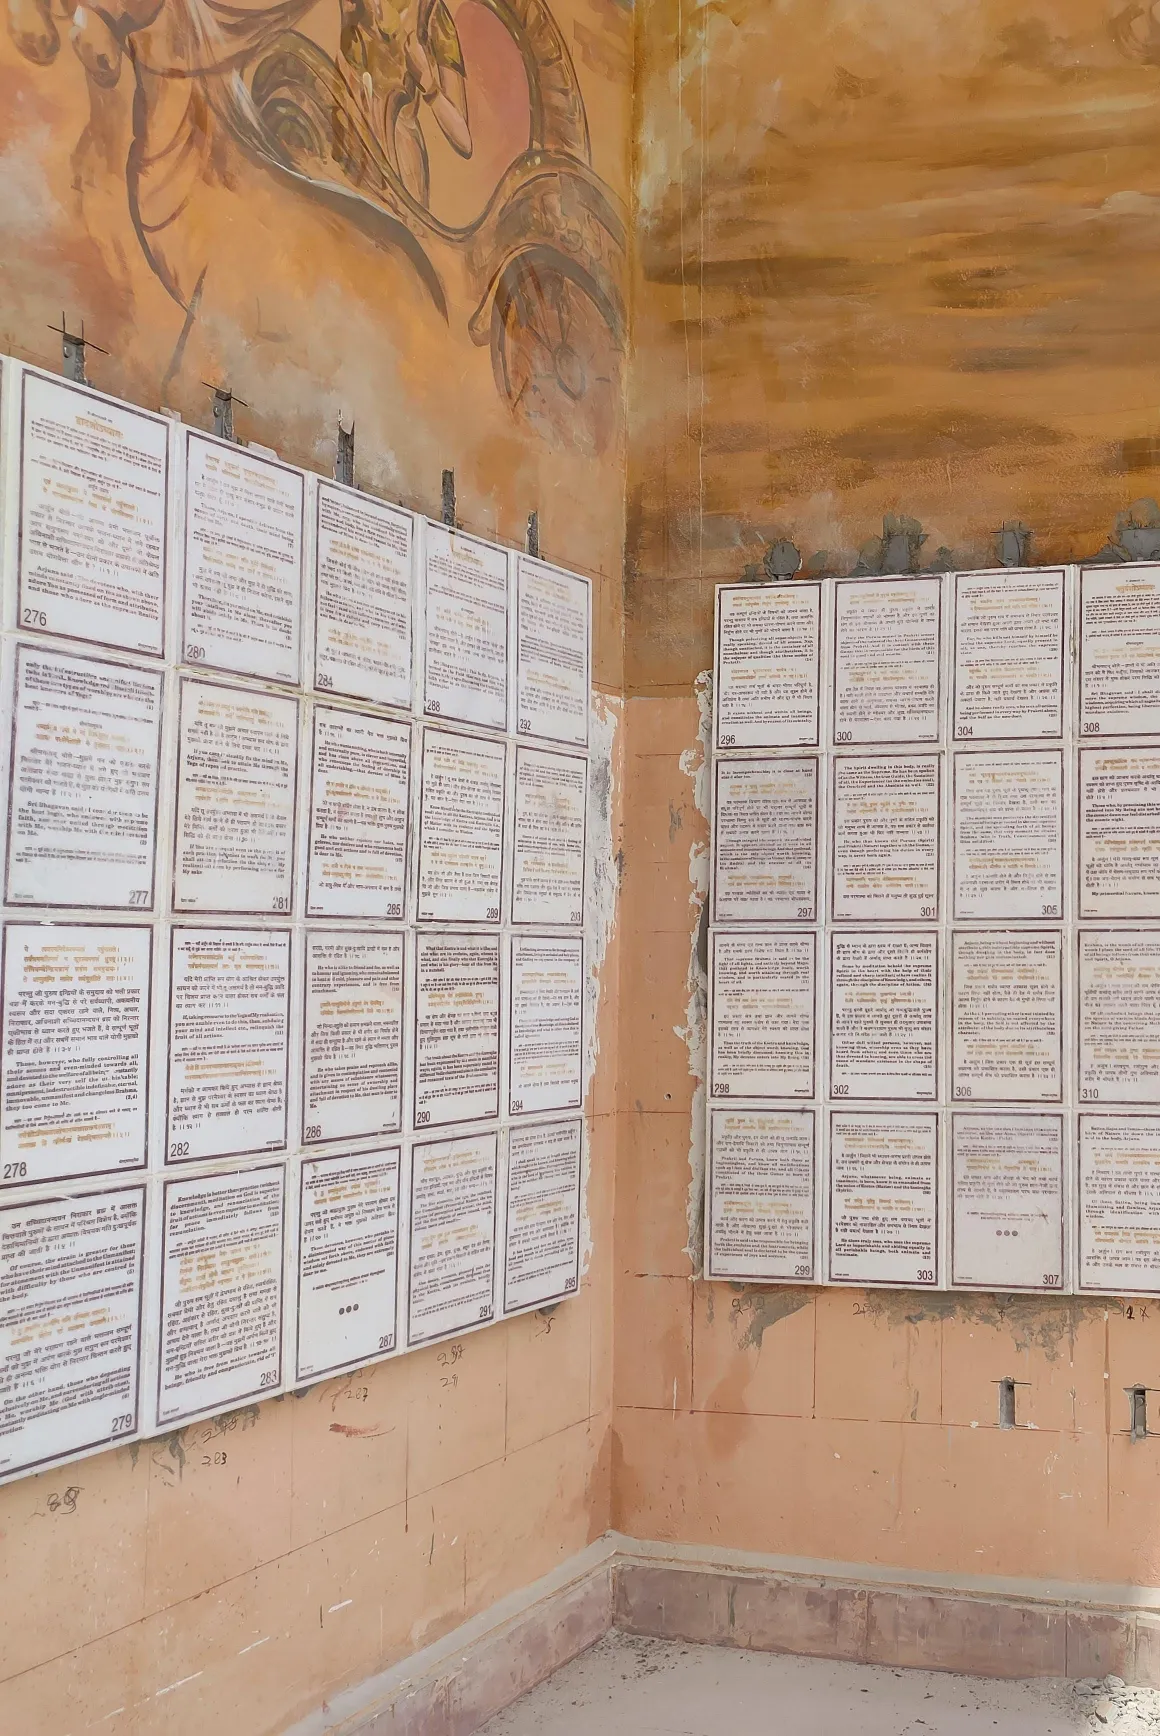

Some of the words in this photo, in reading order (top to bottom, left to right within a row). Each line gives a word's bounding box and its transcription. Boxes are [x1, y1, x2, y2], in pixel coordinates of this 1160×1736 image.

[24, 609, 46, 626] 276
[427, 700, 440, 712] 288
[958, 726, 973, 736] 304
[1084, 723, 1099, 732] 308
[721, 735, 735, 744] 296
[837, 732, 852, 741] 300
[129, 891, 148, 904] 277
[272, 897, 288, 910] 281
[387, 903, 400, 915] 285
[487, 908, 498, 918] 289
[798, 907, 812, 917] 297
[921, 907, 935, 916] 301
[1042, 905, 1057, 915] 305
[715, 1084, 729, 1093] 298
[833, 1085, 849, 1094] 302
[956, 1086, 971, 1096] 306
[1082, 1089, 1098, 1099] 310
[512, 1101, 523, 1111] 294
[417, 1111, 430, 1123] 290
[306, 1125, 321, 1138] 286
[171, 1142, 189, 1157] 282
[4, 1162, 27, 1179] 278
[795, 1265, 810, 1276] 299
[917, 1270, 933, 1280] 303
[564, 1278, 576, 1289] 295
[1043, 1275, 1058, 1284] 307
[480, 1306, 492, 1318] 291
[379, 1334, 392, 1348] 287
[260, 1370, 277, 1386] 283
[112, 1414, 132, 1433] 279
